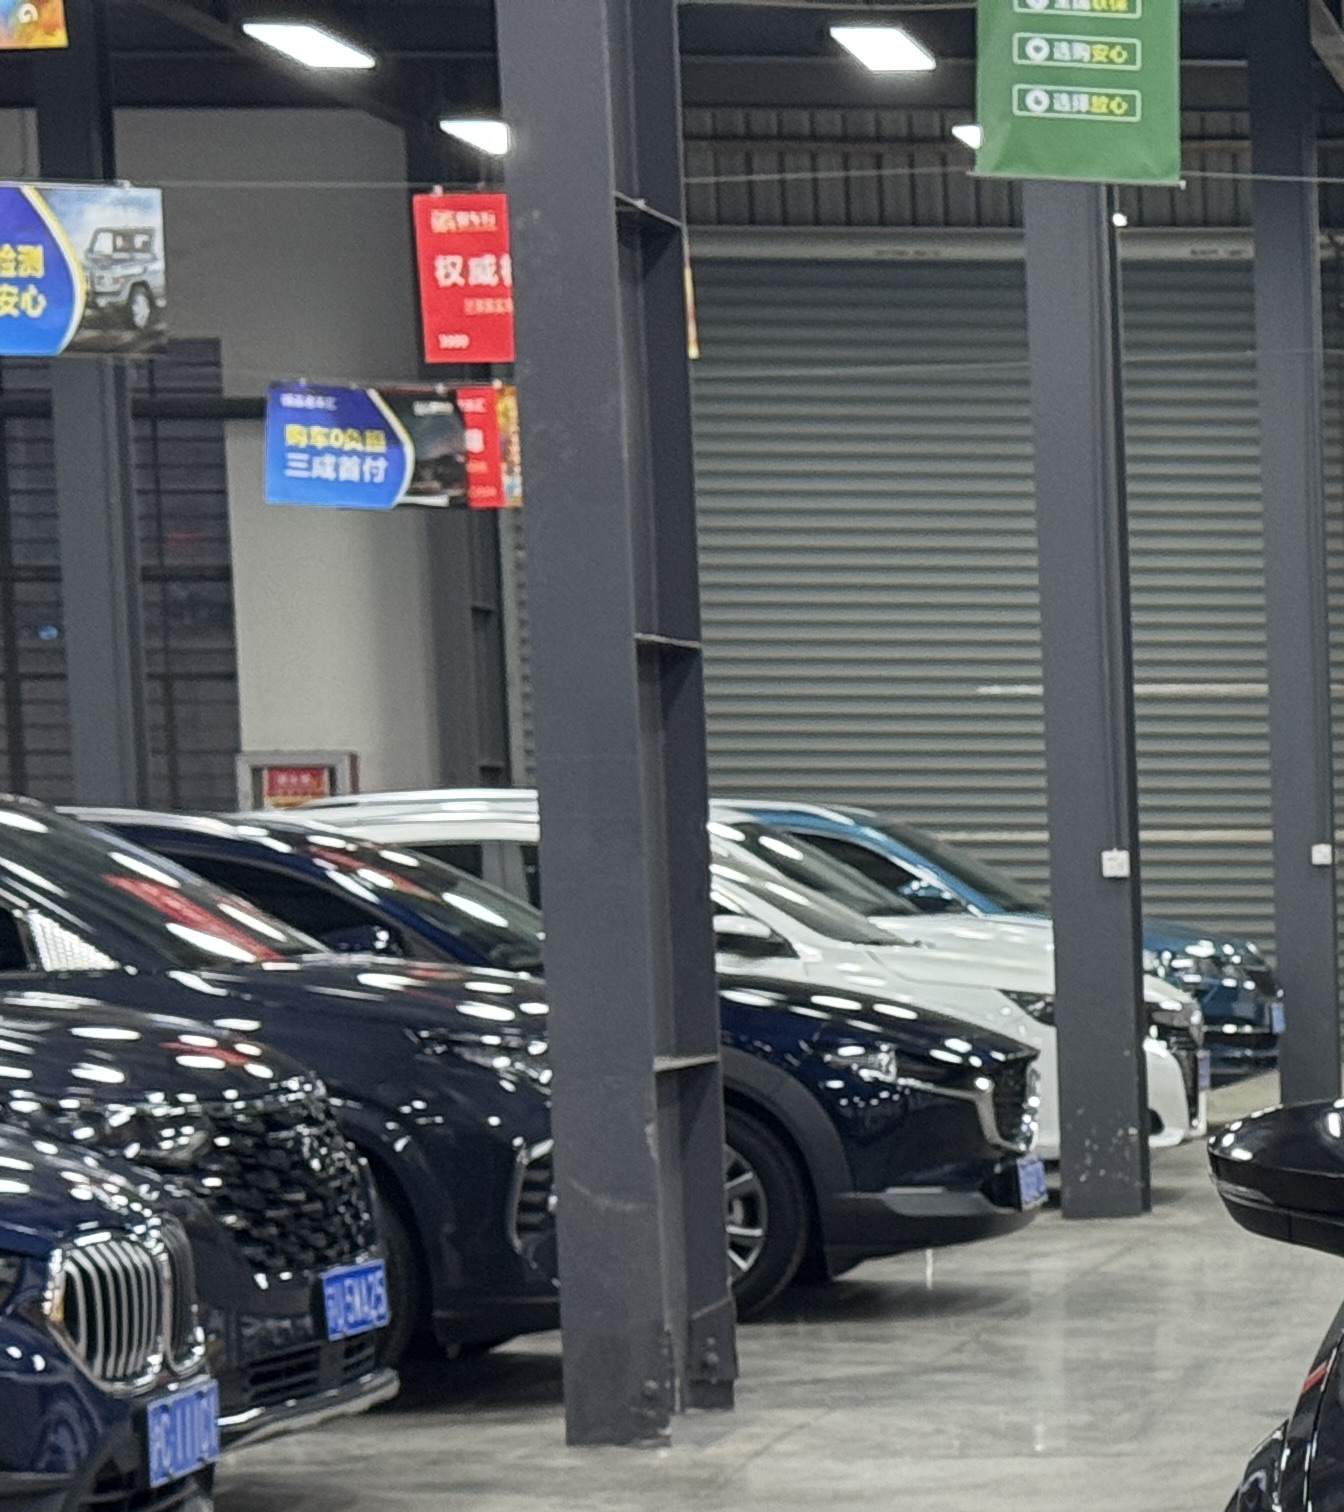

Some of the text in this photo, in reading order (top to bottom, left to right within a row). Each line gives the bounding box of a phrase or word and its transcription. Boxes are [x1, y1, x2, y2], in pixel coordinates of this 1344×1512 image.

[284, 423, 387, 454] 购车0负担
[284, 452, 388, 483] 三成首付
